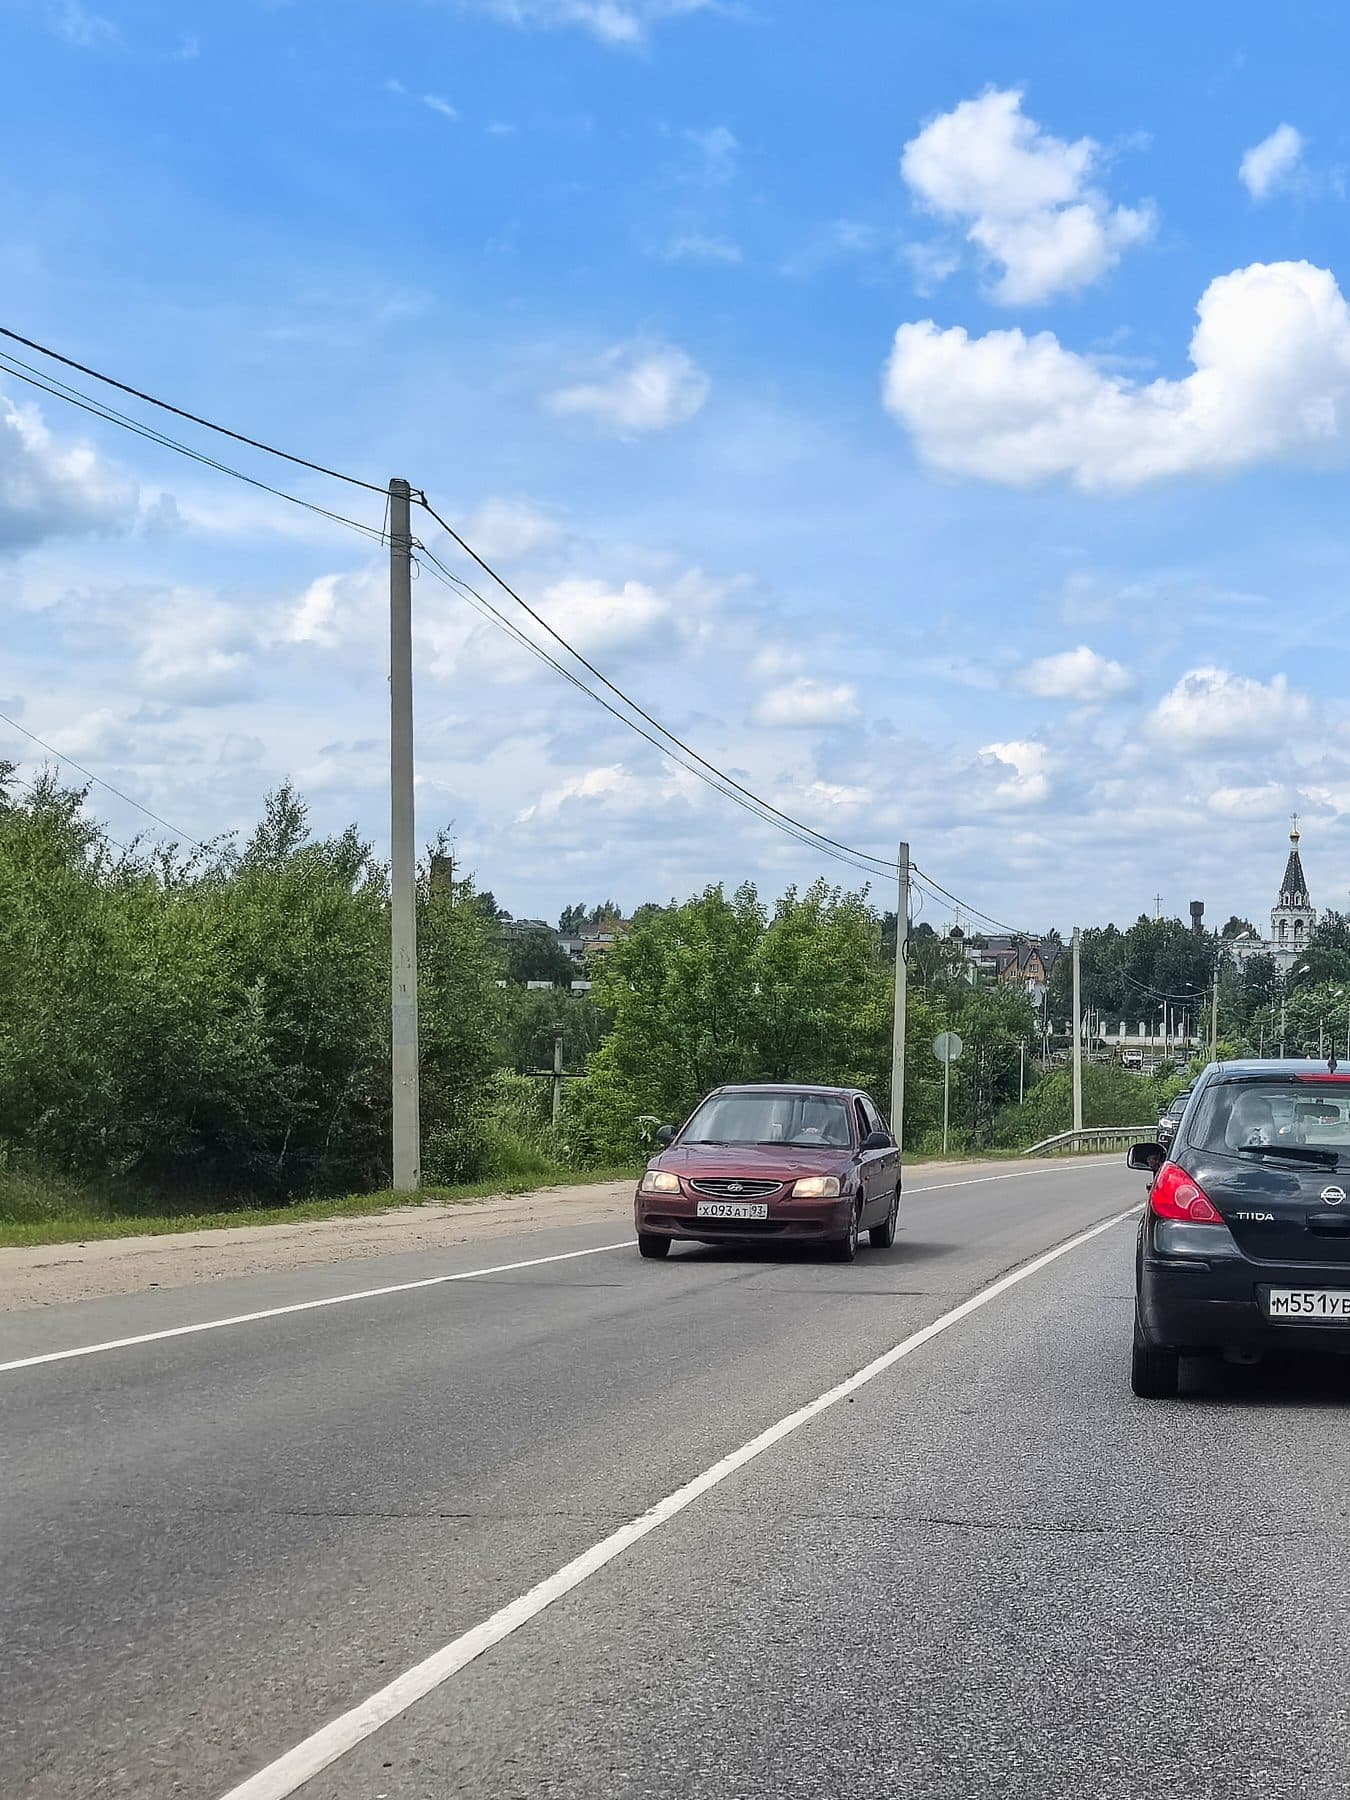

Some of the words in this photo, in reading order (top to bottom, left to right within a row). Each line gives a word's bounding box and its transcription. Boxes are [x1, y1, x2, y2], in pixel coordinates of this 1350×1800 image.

[702, 1204, 748, 1217] Х093АТ
[751, 1205, 763, 1214] 93
[1236, 1212, 1274, 1221] TIIDA
